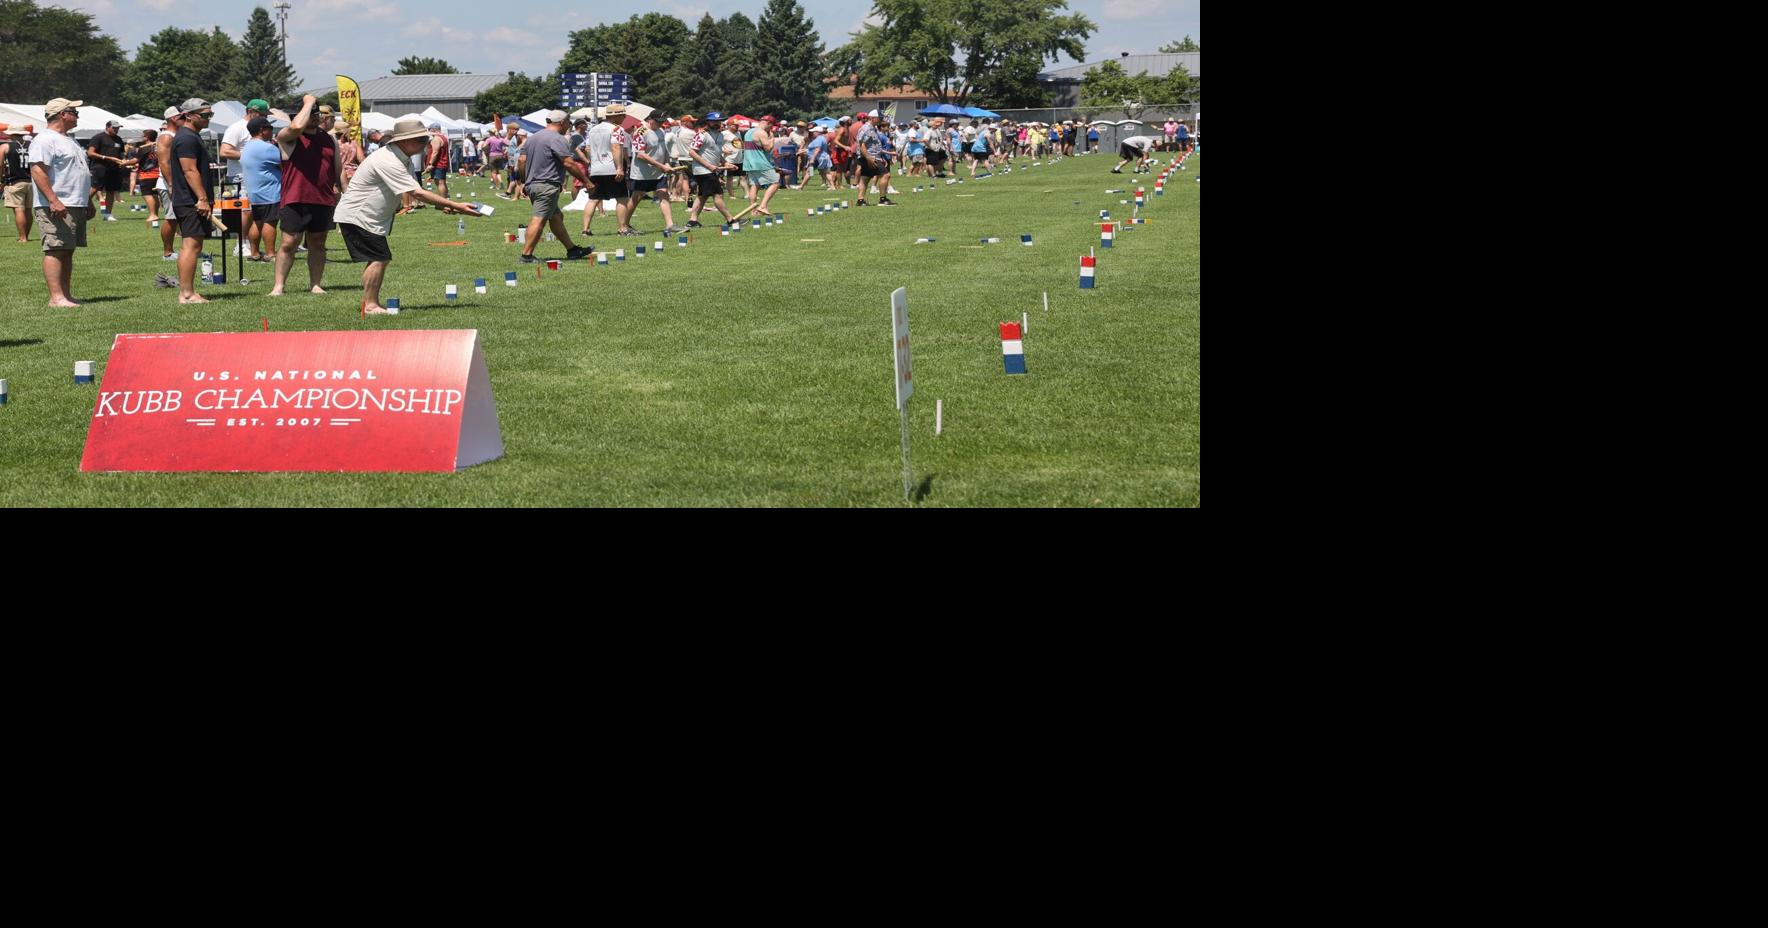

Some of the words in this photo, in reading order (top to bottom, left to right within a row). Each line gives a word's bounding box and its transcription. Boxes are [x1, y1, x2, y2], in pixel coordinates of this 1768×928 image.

[340, 90, 356, 99] ECK
[193, 371, 239, 381] U.S.
[254, 370, 377, 380] NATIONAL
[95, 390, 183, 417] KUBB
[194, 388, 462, 415] CHAMPIONSHIP
[226, 418, 265, 426] EST.
[276, 418, 321, 426] 2007
